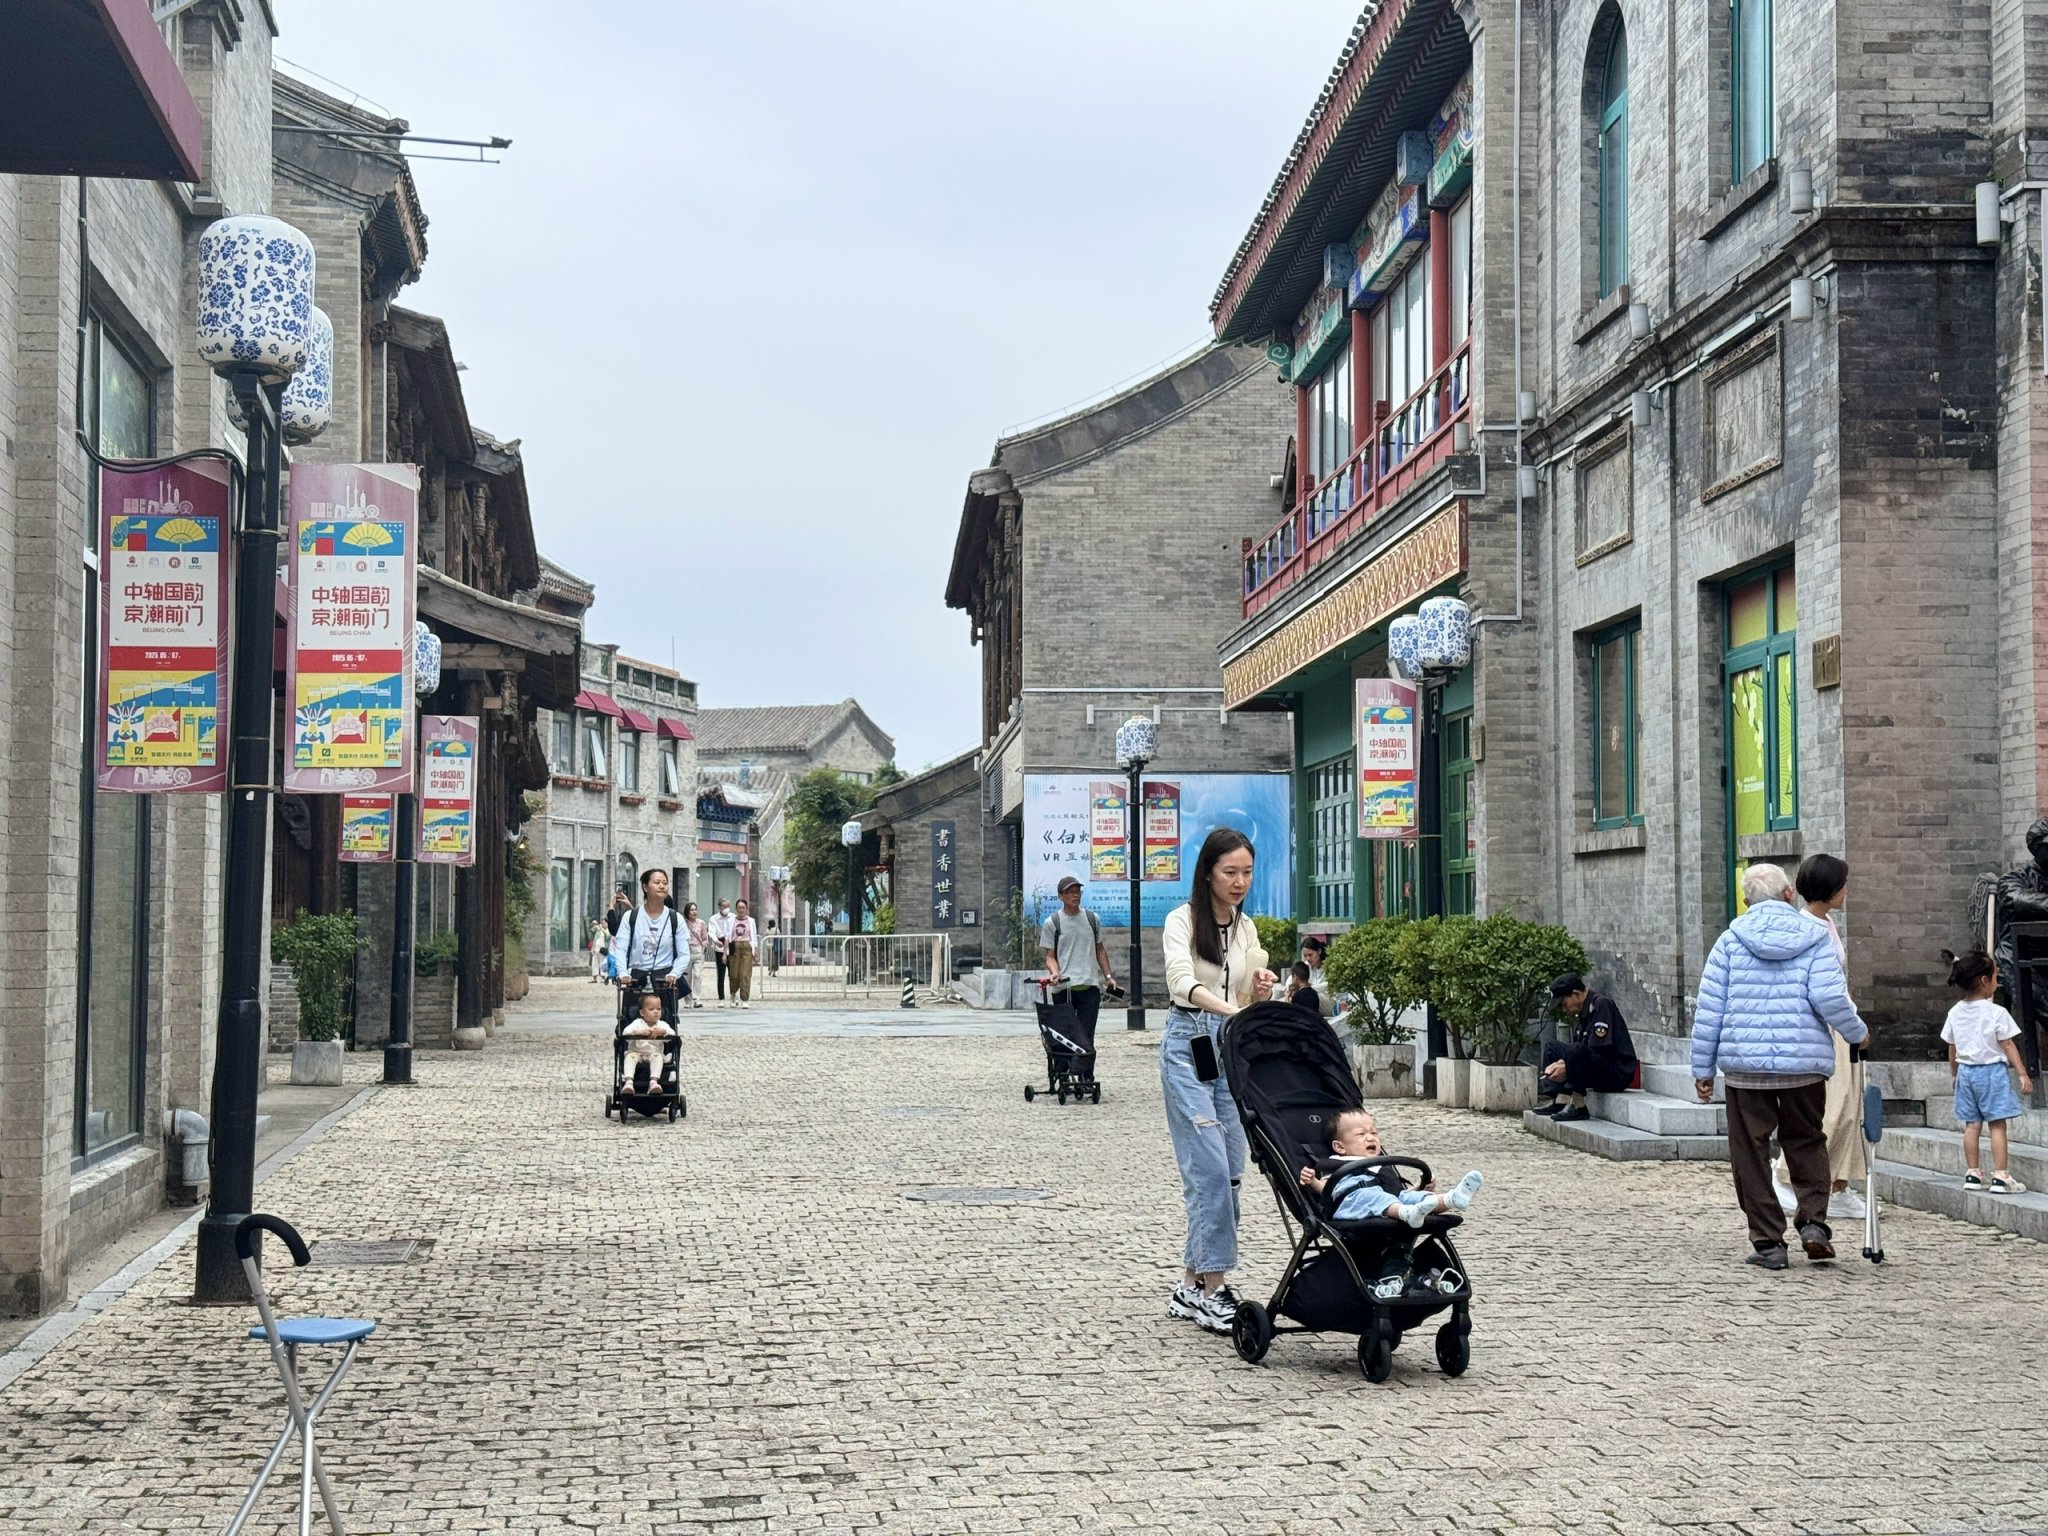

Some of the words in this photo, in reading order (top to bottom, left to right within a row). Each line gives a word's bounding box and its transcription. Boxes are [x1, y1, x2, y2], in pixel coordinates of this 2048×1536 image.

[124, 582, 204, 604] 中轴国韵
[311, 585, 390, 606] 中轴国韵
[124, 605, 203, 627] 京潮前门
[311, 608, 390, 629] 京潮前门
[1043, 852, 1060, 862] VR
[934, 828, 952, 919] 書香世業
